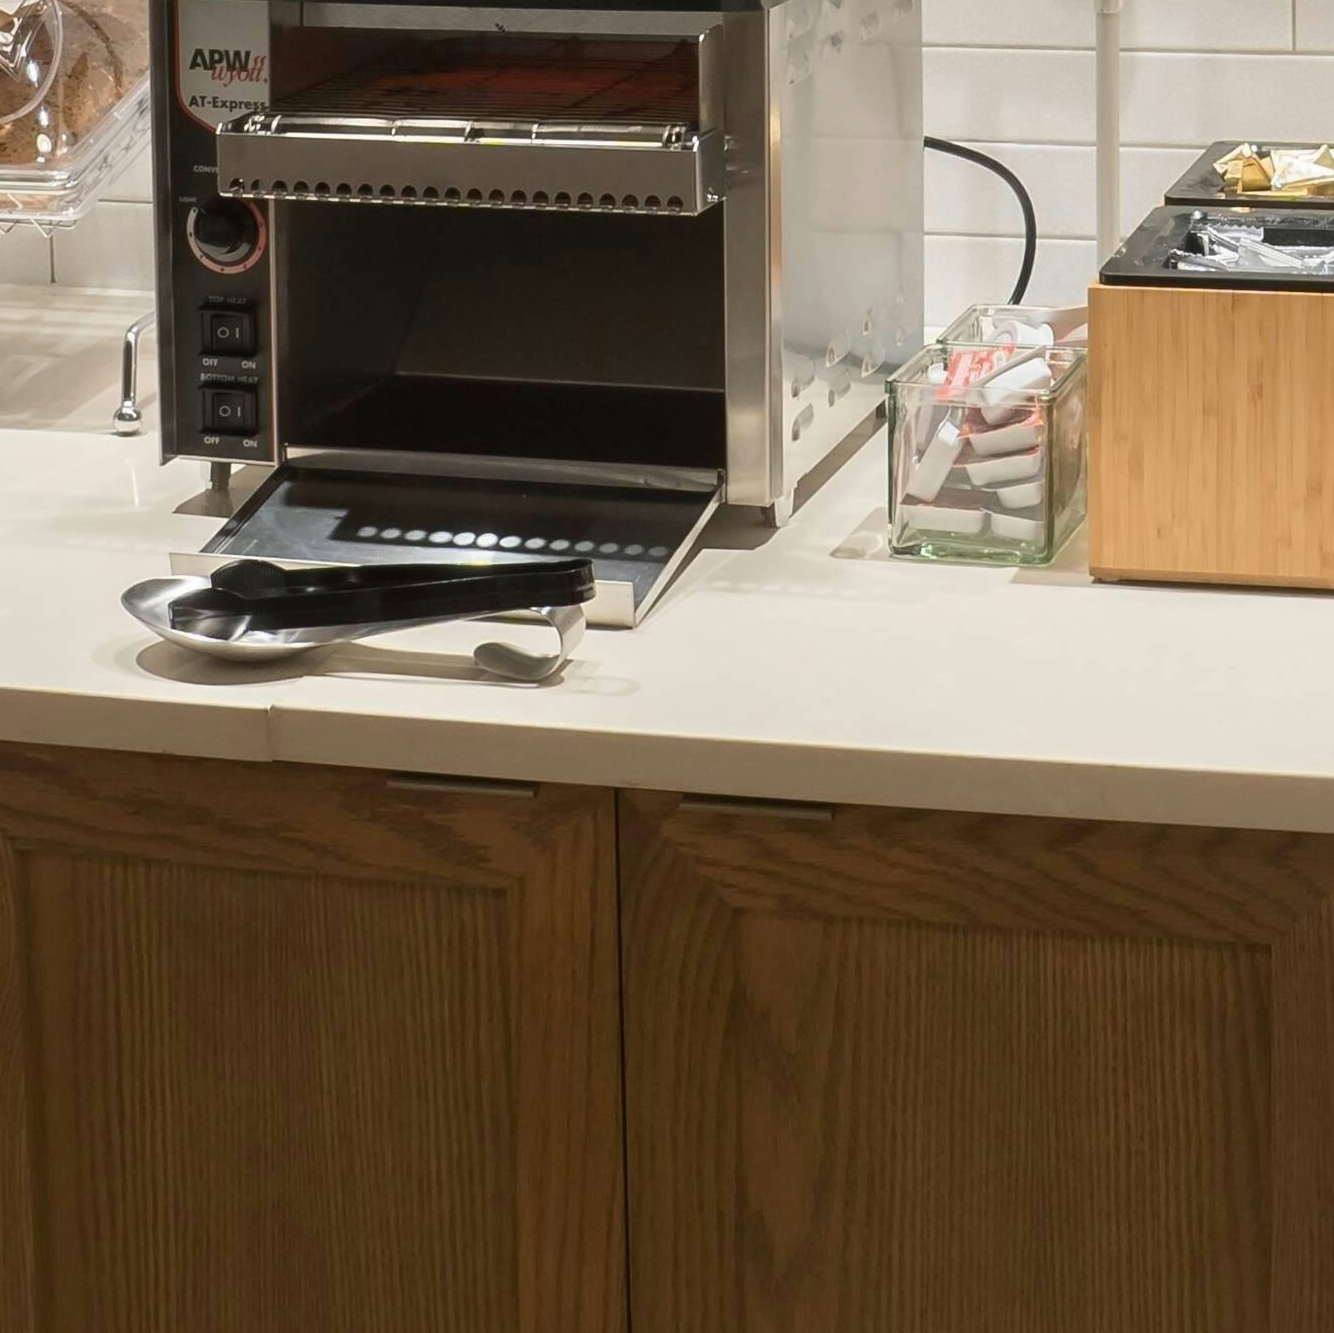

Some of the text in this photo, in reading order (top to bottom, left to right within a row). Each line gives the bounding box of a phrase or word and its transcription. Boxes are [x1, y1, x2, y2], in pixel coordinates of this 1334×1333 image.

[188, 48, 252, 71] APW
[188, 94, 267, 113] AT-Express
[202, 357, 256, 369] OFF ON
[203, 435, 258, 448] OFF ON
